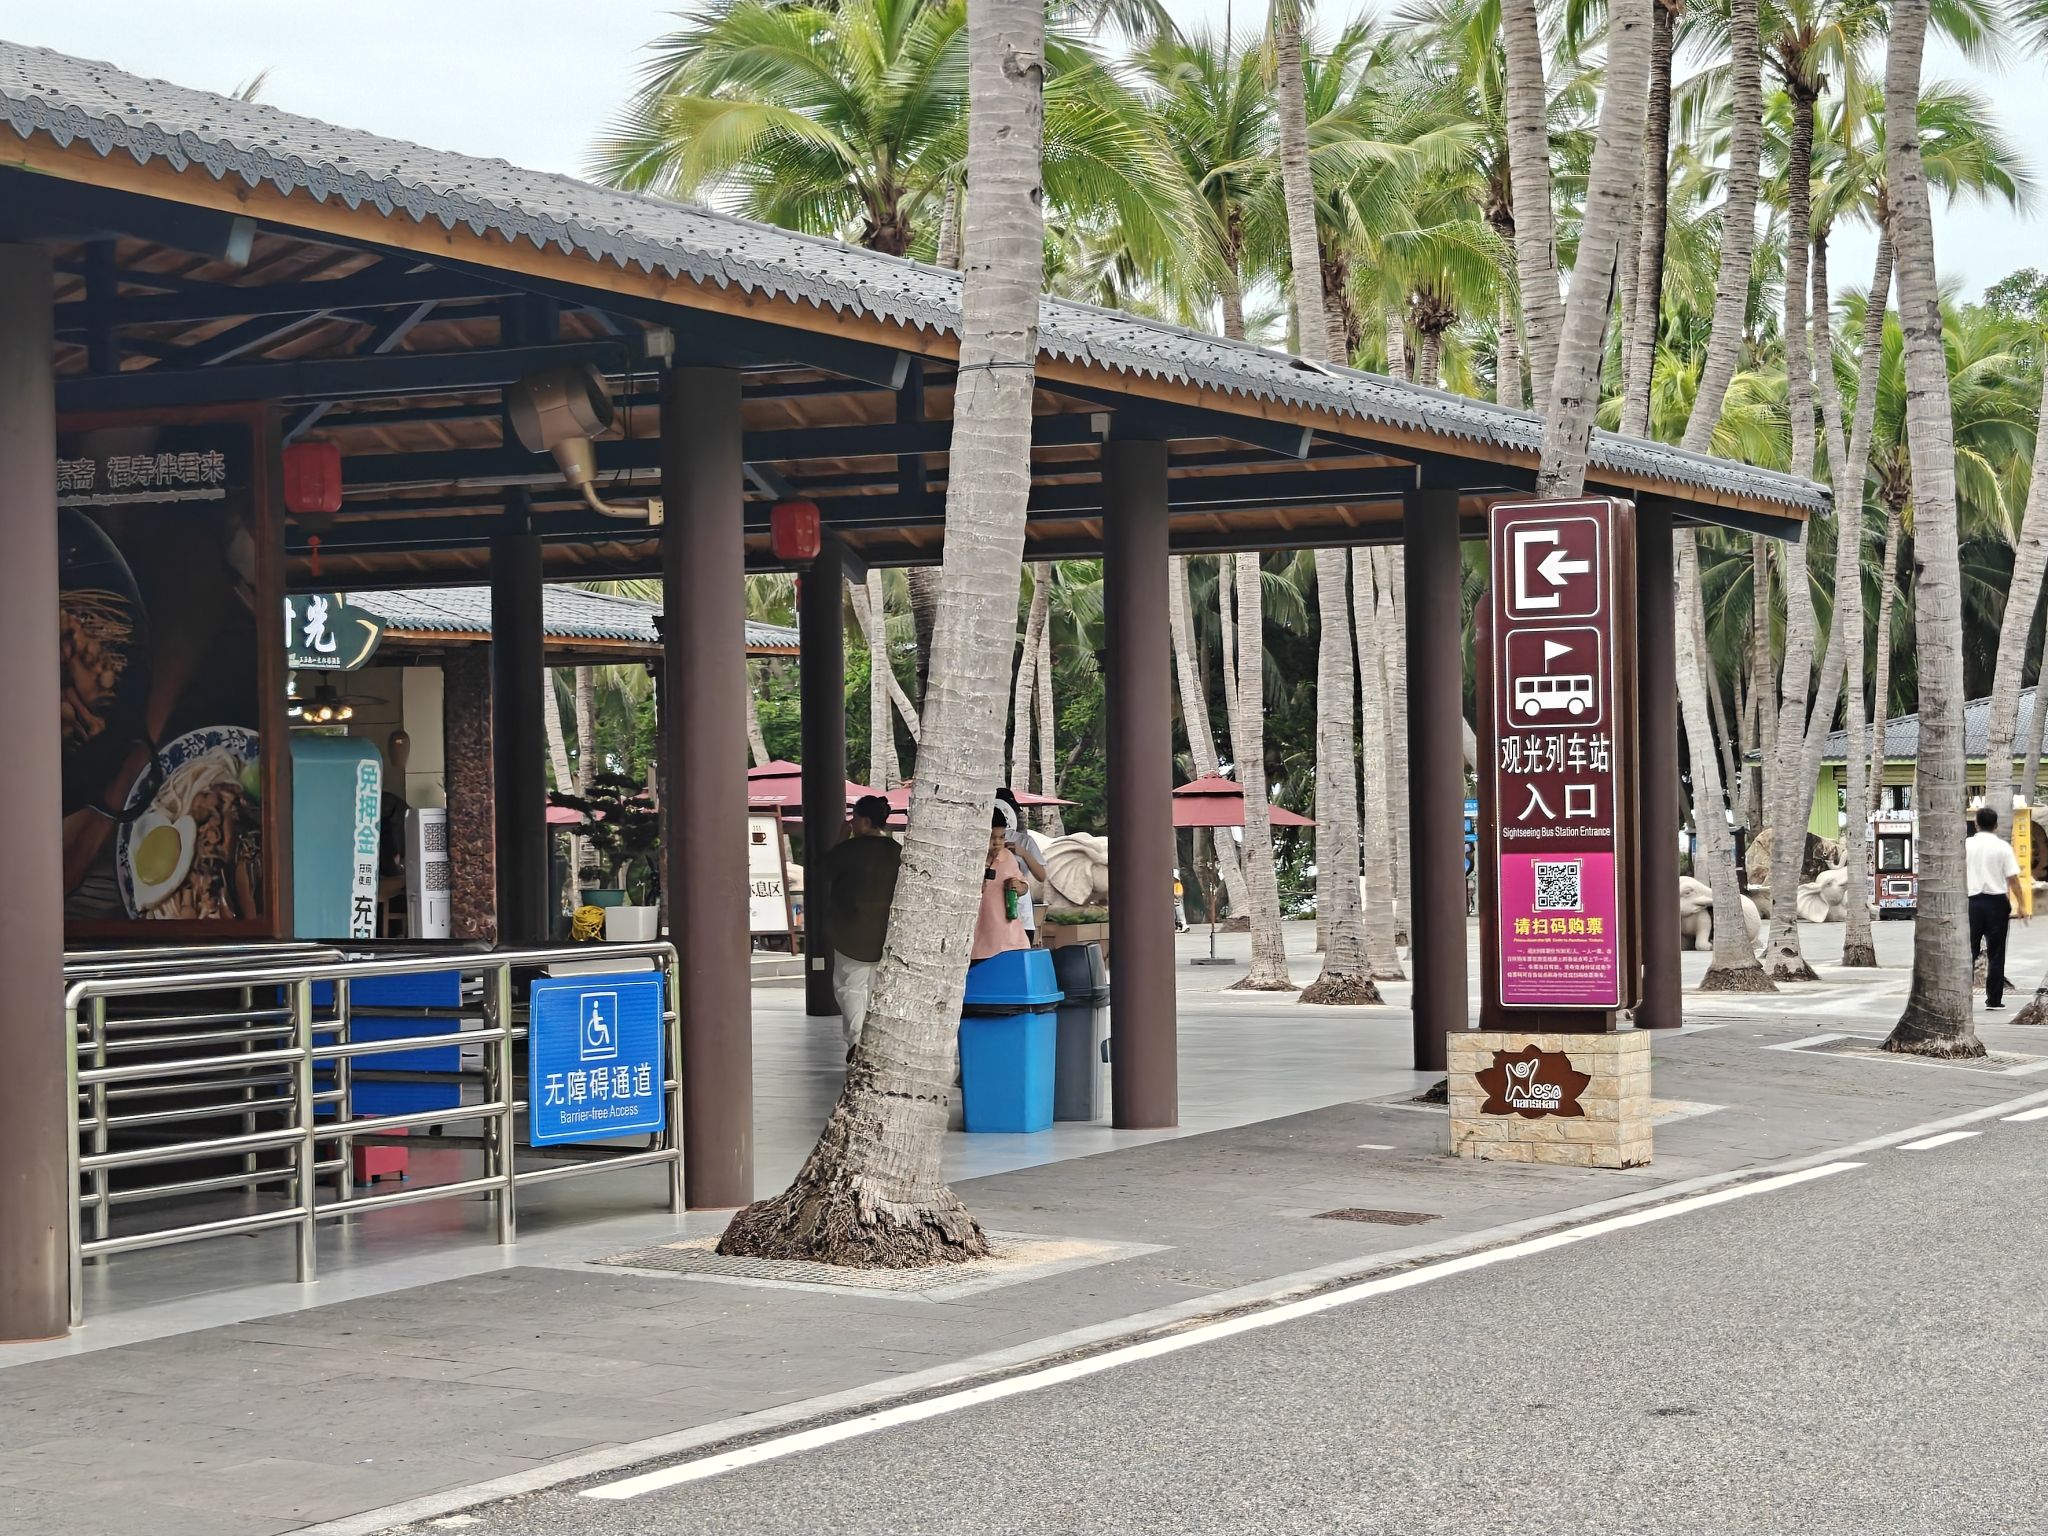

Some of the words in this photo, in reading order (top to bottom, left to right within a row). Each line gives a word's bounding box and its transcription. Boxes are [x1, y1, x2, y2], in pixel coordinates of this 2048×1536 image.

[107, 450, 225, 488] 福寿伴君来
[1500, 732, 1610, 774] 观光列车站
[357, 764, 379, 855] 免押金
[1517, 783, 1596, 820] 入口
[1502, 826, 1541, 840] Sightseeing
[1541, 826, 1554, 837] Bus
[1555, 825, 1579, 837] Station
[1580, 825, 1611, 837] Entrance
[1513, 917, 1604, 935] 请扫码购票
[544, 1062, 653, 1106] 无障碍通道
[560, 1107, 610, 1124] Barrier-free
[610, 1104, 639, 1117] Access
